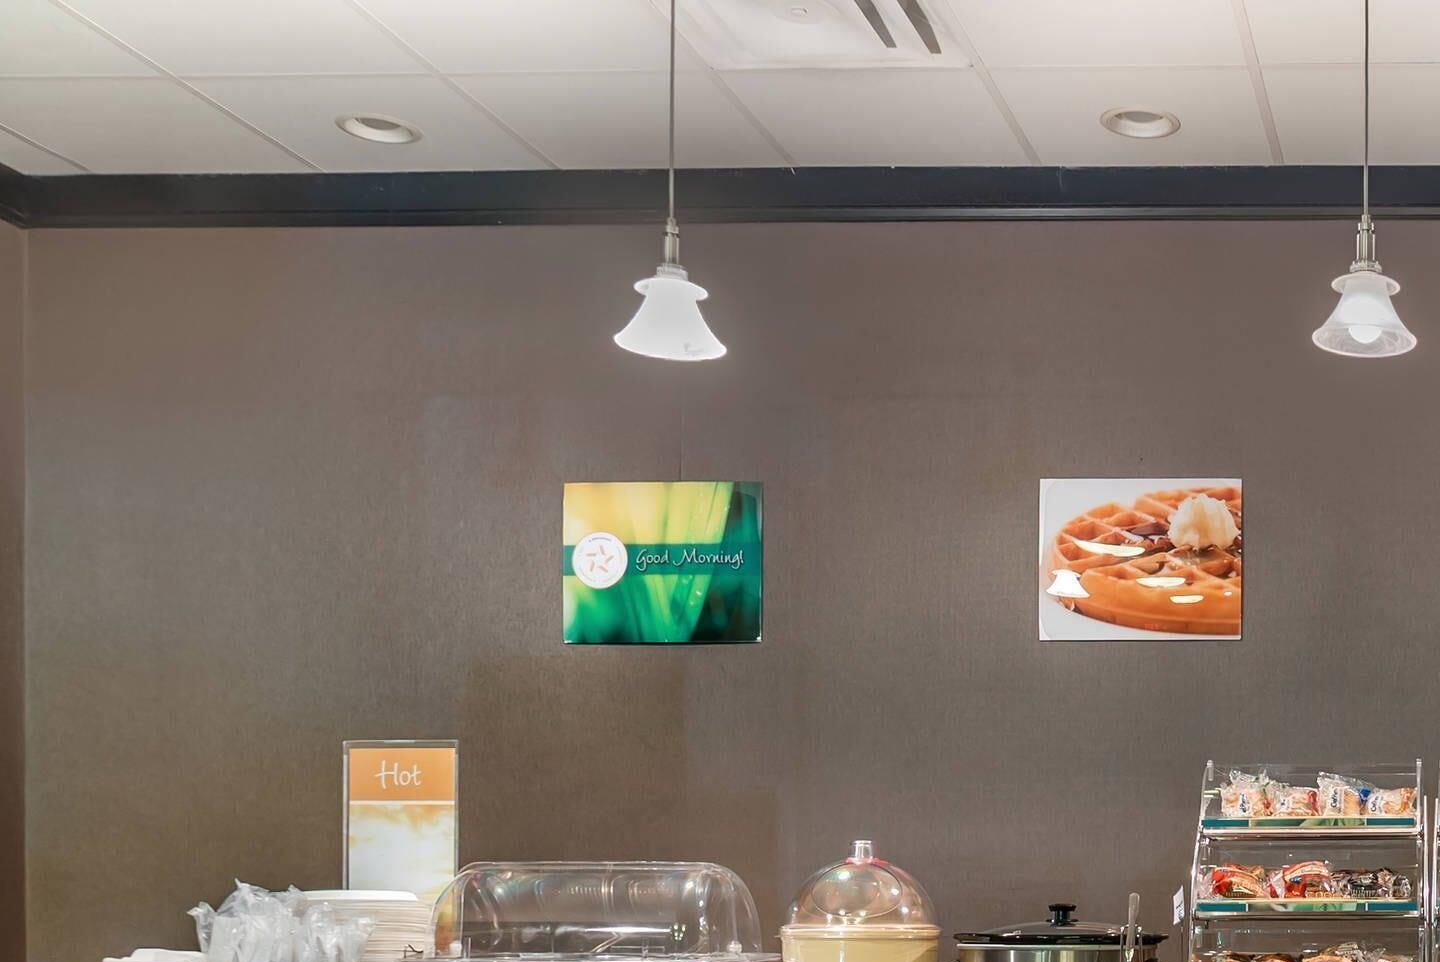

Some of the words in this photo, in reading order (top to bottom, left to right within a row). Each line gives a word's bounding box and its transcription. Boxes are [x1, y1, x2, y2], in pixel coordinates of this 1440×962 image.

[636, 548, 669, 571] Good
[673, 548, 744, 569] Morning!
[374, 760, 422, 789] Hot
